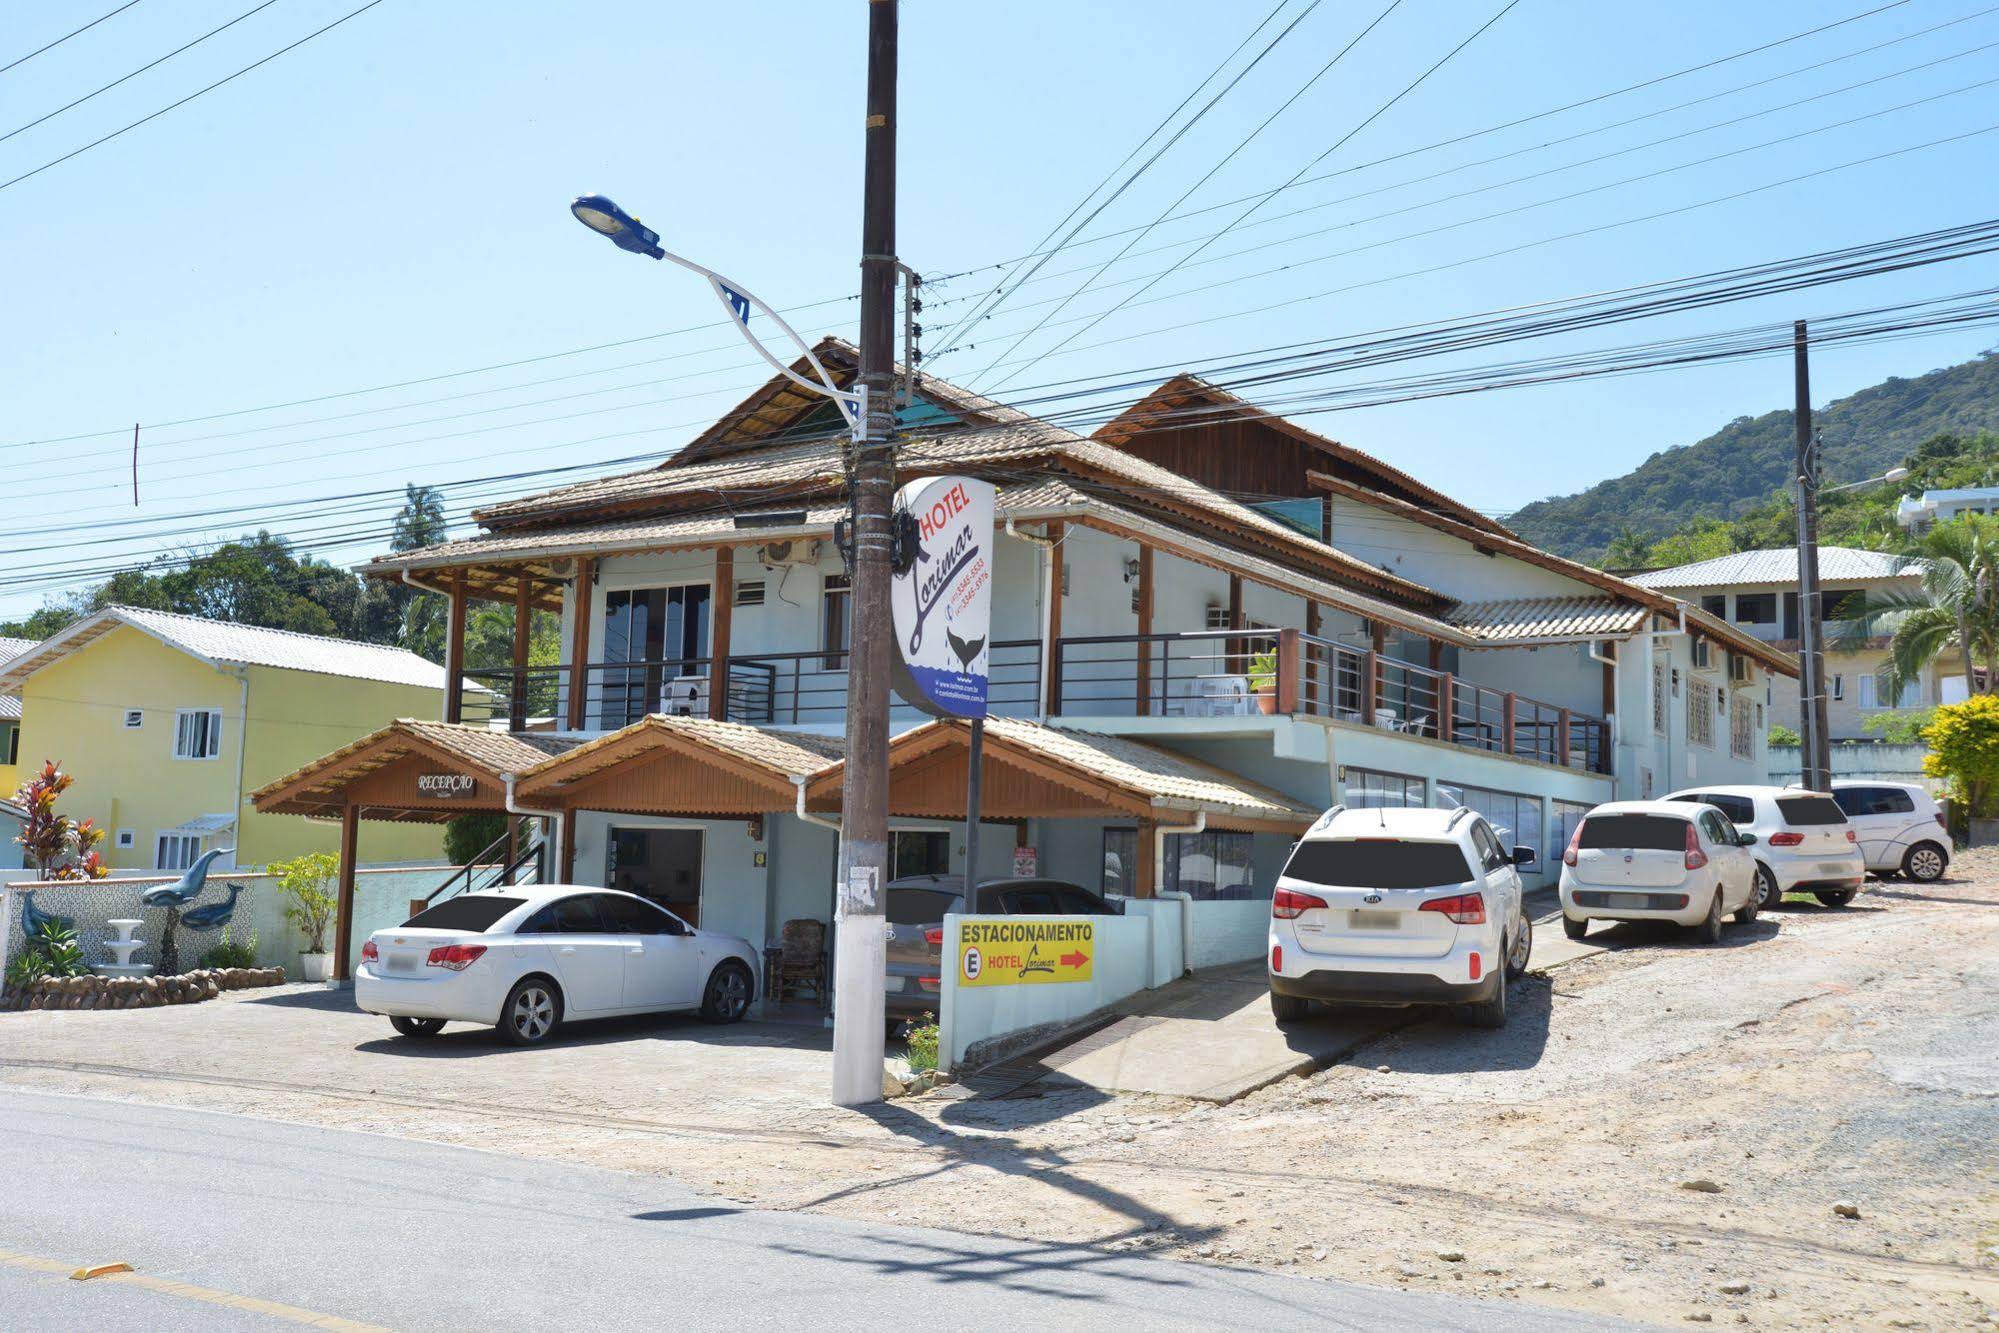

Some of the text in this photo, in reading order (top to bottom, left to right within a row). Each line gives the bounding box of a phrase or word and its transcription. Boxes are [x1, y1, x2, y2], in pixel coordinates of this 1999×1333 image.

[919, 483, 970, 542] HOTEL
[961, 924, 1092, 942] ESTACIONAMENTO
[968, 954, 977, 972] E
[988, 956, 1023, 968] HOTEL
